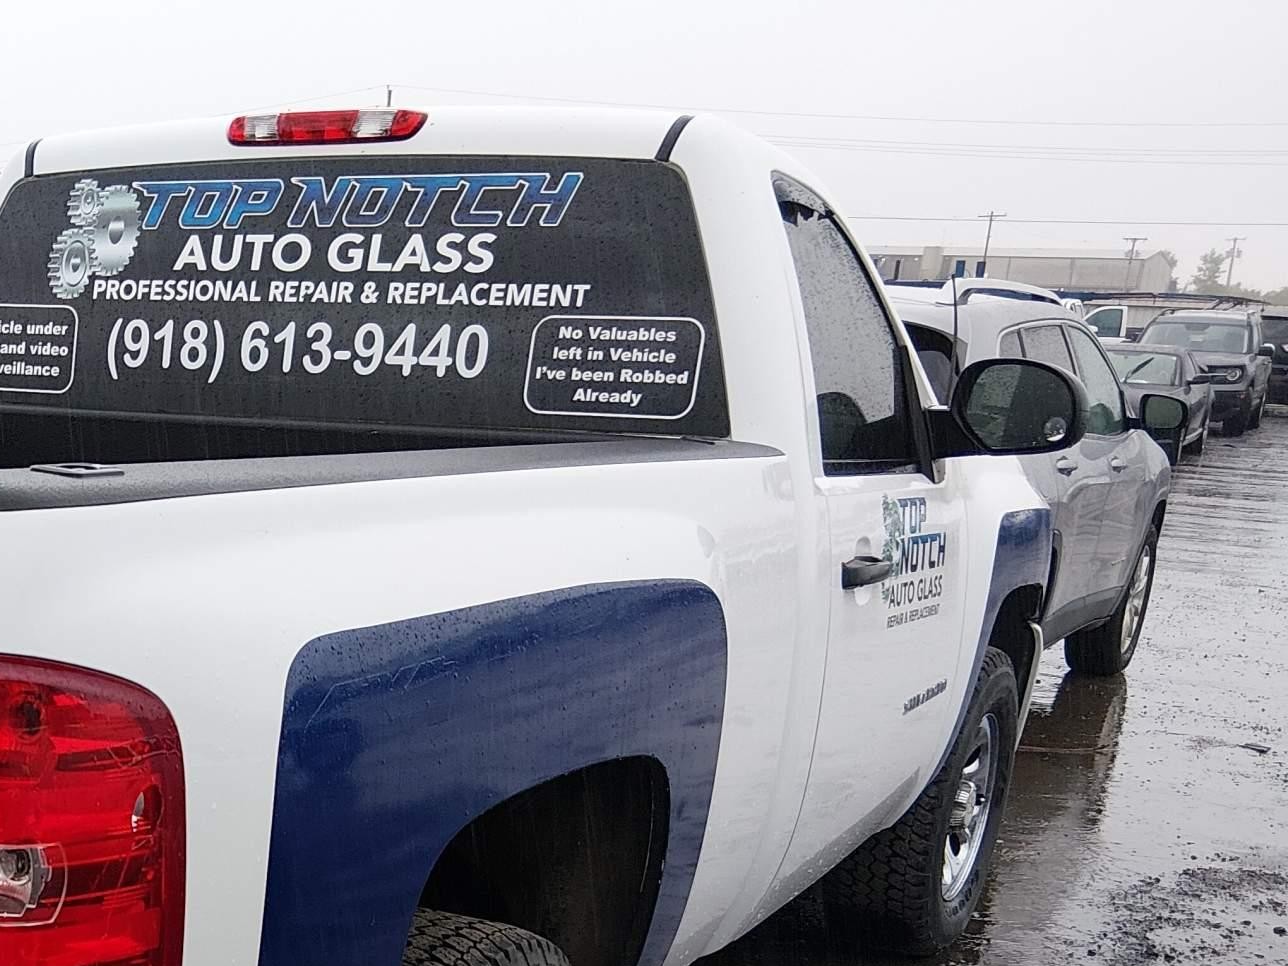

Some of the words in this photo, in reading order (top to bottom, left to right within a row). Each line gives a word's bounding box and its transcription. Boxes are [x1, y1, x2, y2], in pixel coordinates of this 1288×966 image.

[132, 178, 283, 230] TOP
[288, 171, 585, 228] NOTCH
[173, 233, 312, 272] AUTO
[327, 232, 498, 272] GLASS
[92, 279, 261, 303] PROFESSIONAL
[269, 281, 354, 305] REPAIR
[361, 282, 379, 305] &
[386, 283, 591, 308] REPLACEMENT
[26, 322, 68, 335] under
[558, 325, 583, 340] No
[588, 326, 677, 342] Valuables
[0, 341, 26, 354] and
[30, 342, 68, 356] video
[107, 317, 225, 383] (918)
[240, 321, 489, 379] 613-9440
[552, 346, 582, 361] left
[587, 346, 604, 361] in
[609, 347, 677, 363] Vehicle
[535, 366, 566, 380] I've
[570, 367, 614, 382] been
[619, 368, 689, 385] Robbed
[572, 388, 643, 407] Already
[898, 497, 927, 535] TOP
[899, 532, 946, 575] NOTCH
[888, 581, 915, 609] AUTO
[916, 575, 943, 602] GLASS
